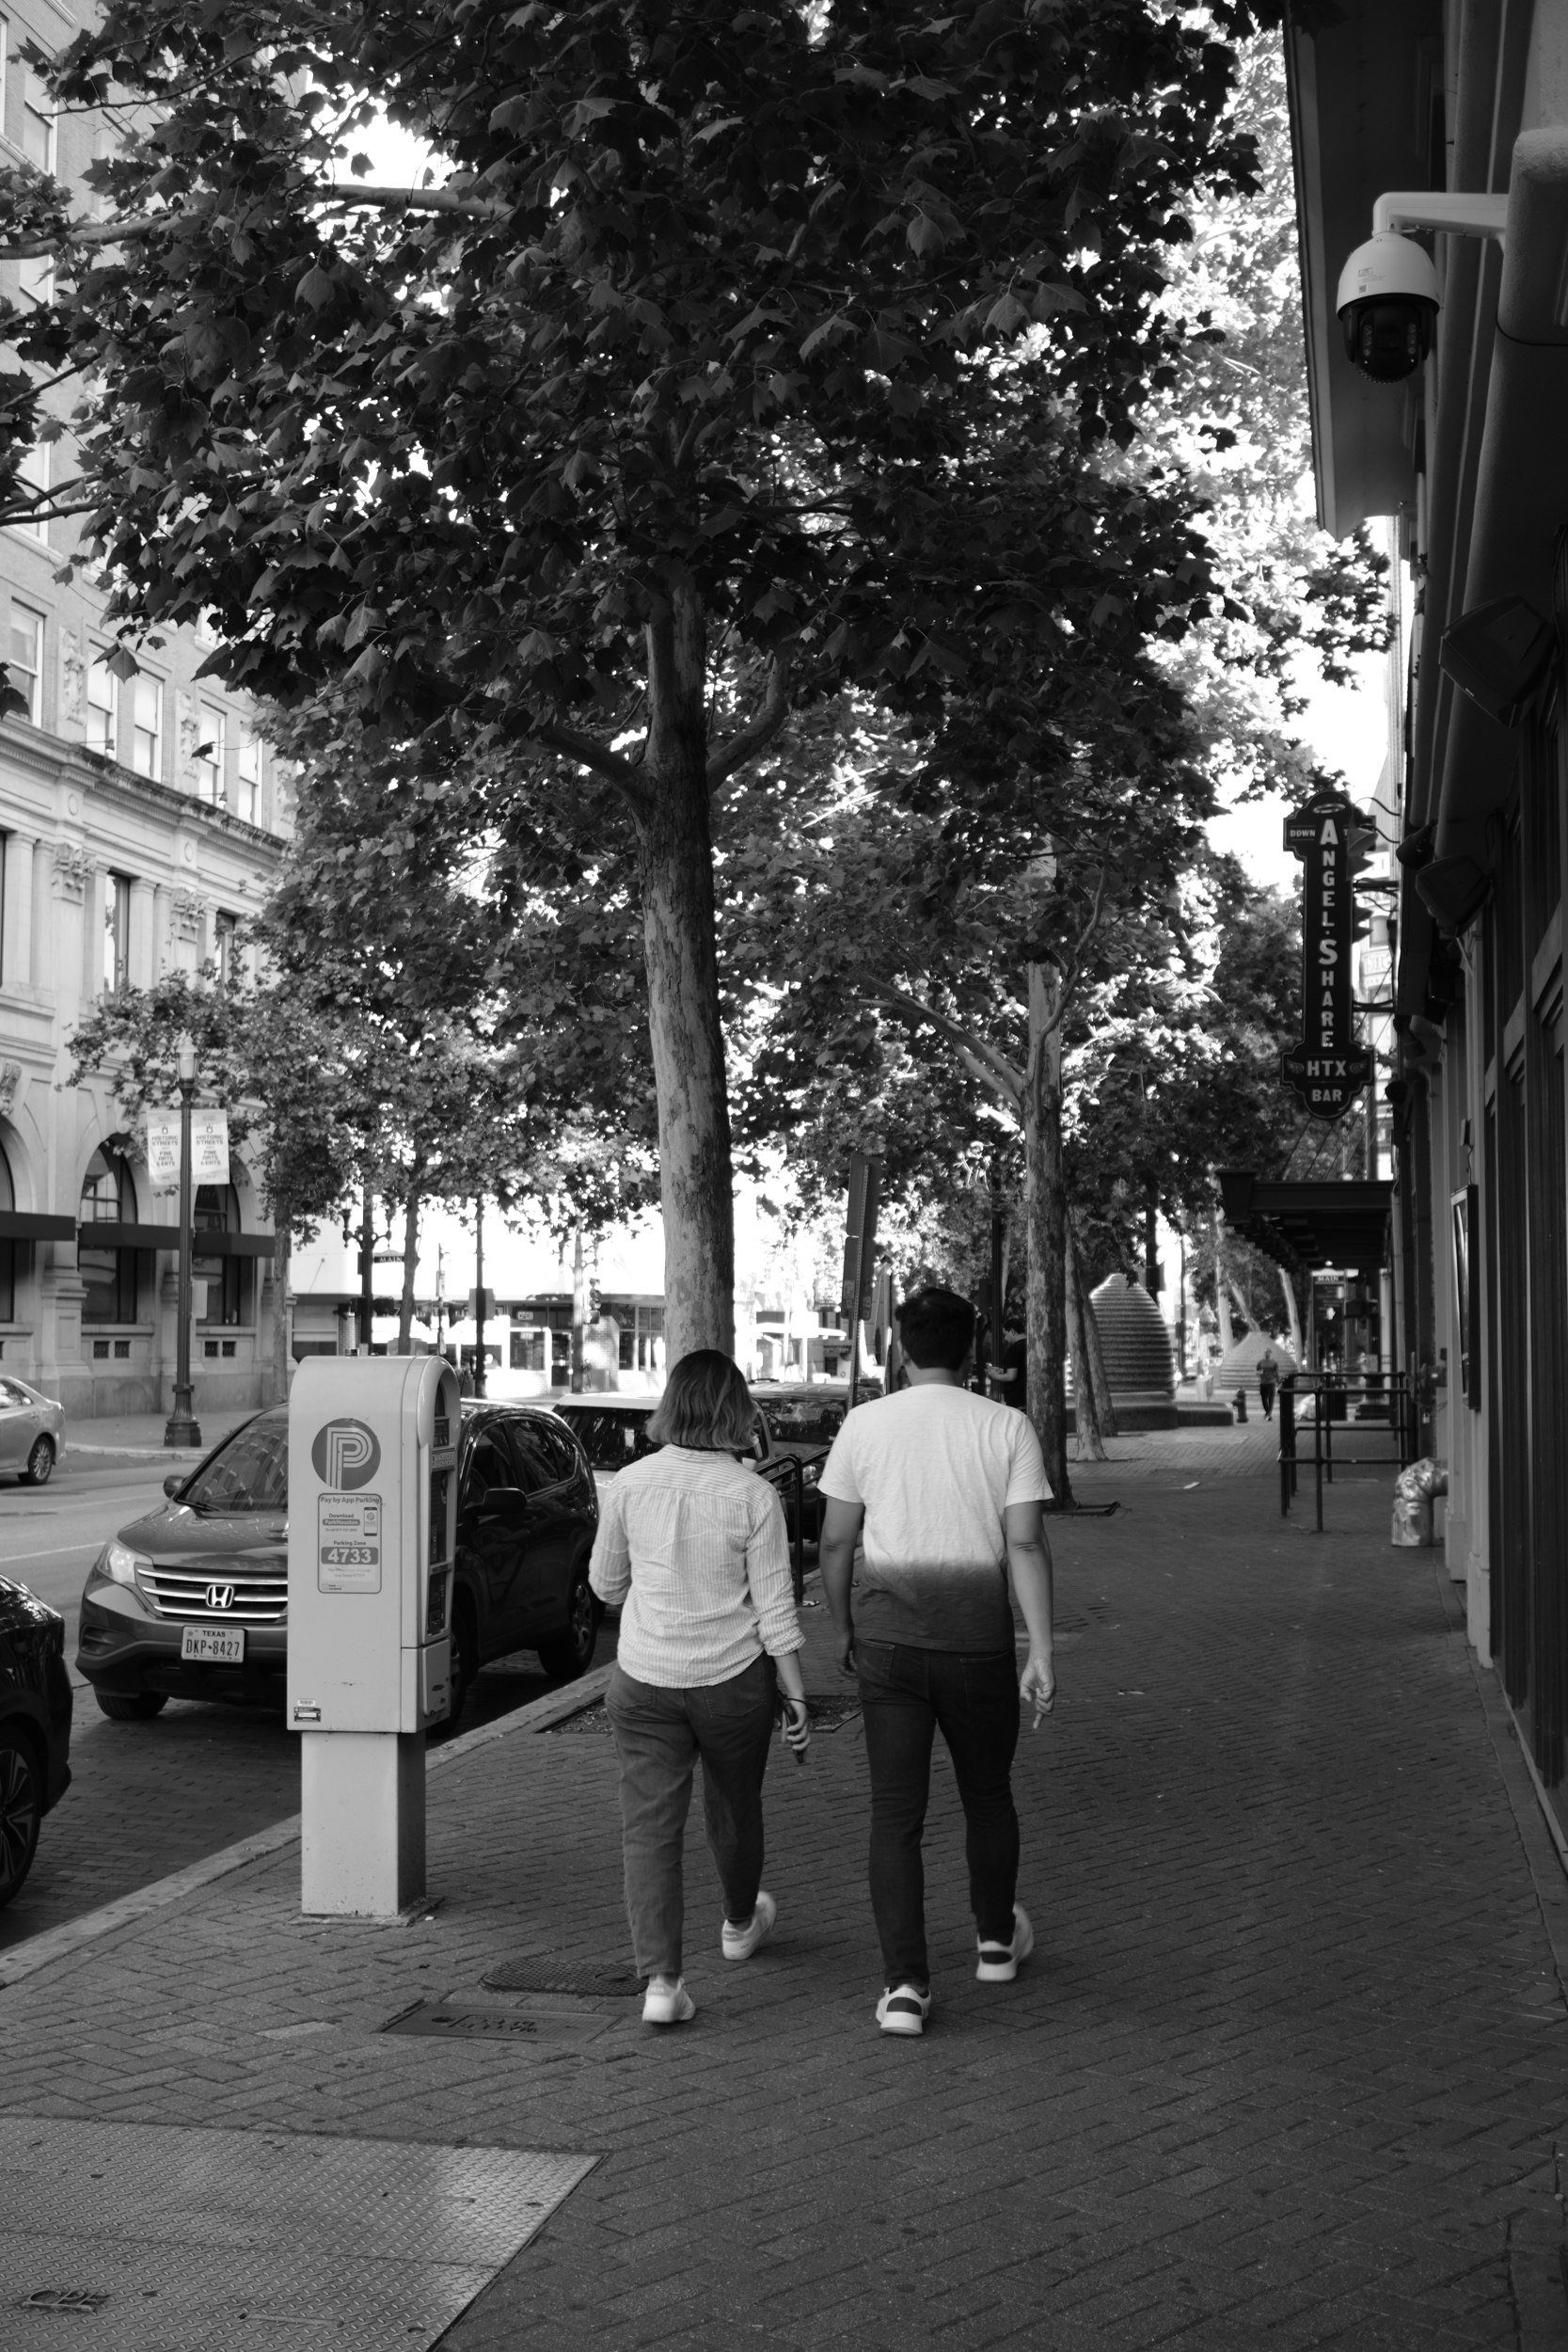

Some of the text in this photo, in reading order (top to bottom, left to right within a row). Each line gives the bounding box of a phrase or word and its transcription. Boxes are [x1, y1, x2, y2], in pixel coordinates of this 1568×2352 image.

[1290, 829, 1316, 837] DOWN
[1318, 818, 1339, 1048] ANGEL SHARE
[1307, 1060, 1347, 1077] HTX
[1311, 1089, 1343, 1103] BAR
[325, 1426, 373, 1491] P
[327, 1548, 372, 1564] 4733
